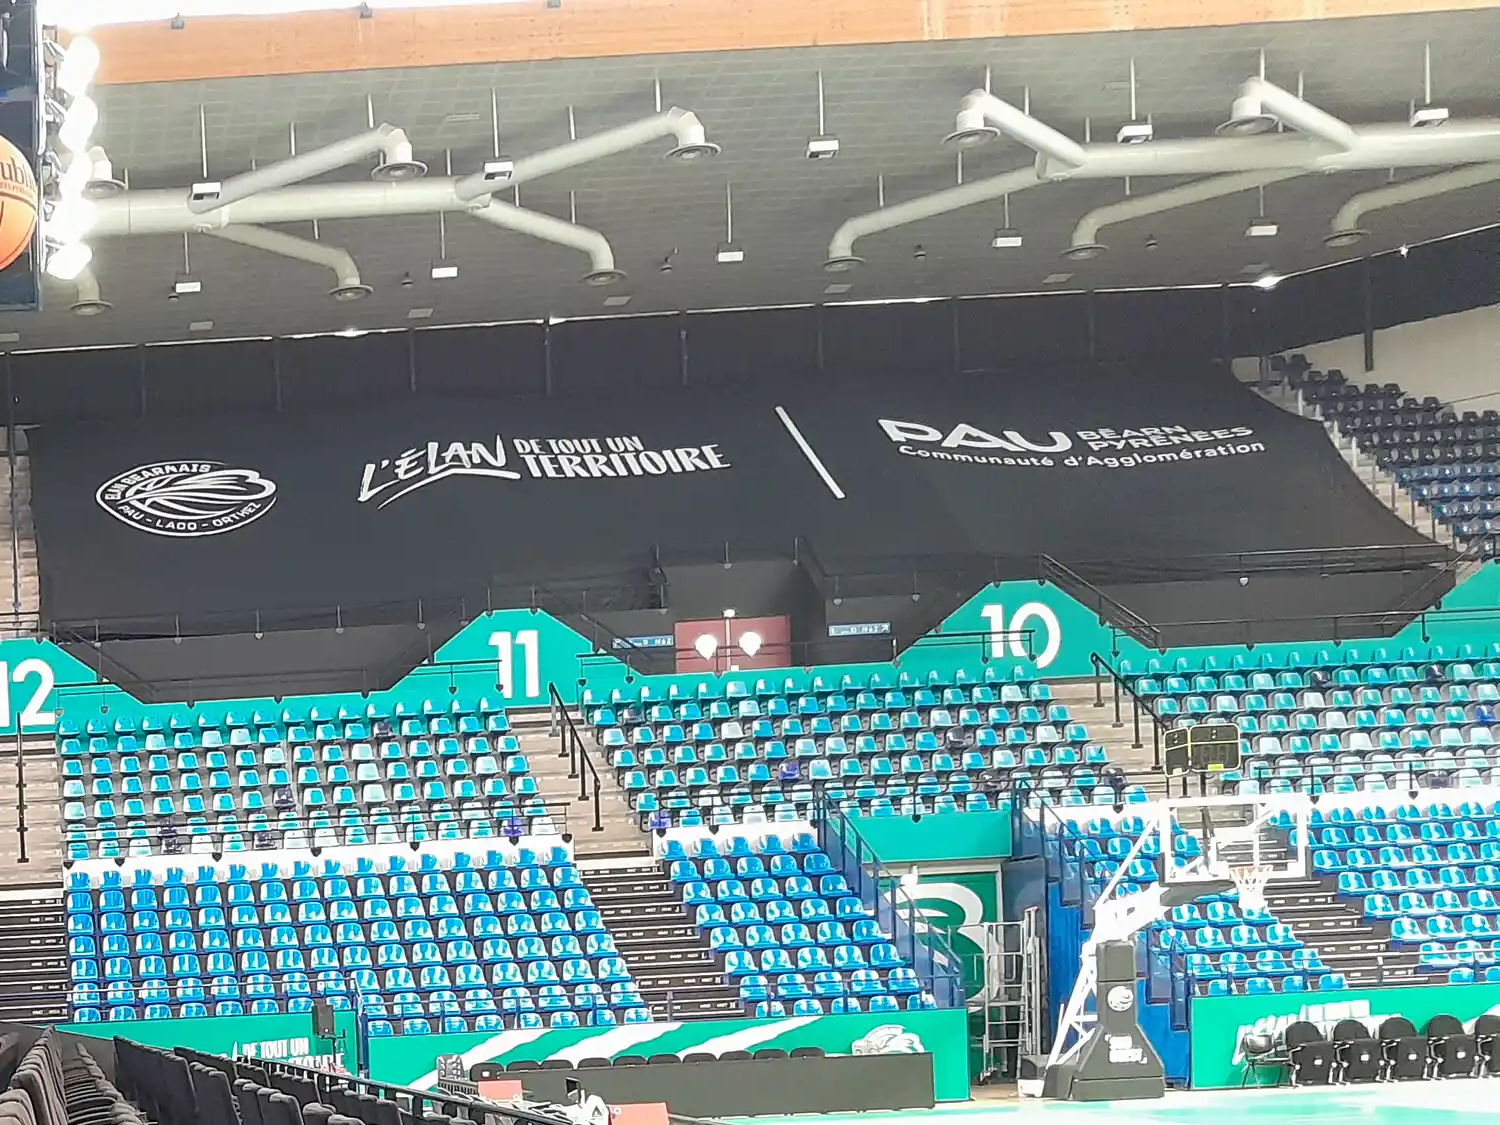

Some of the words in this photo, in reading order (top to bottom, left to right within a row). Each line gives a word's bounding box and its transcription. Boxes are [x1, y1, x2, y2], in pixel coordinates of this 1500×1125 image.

[512, 438, 546, 455] DE
[545, 438, 600, 454] TOUT
[605, 436, 645, 453] UN
[877, 419, 1072, 453] PAU
[357, 434, 507, 503] L'ÉLAN
[520, 444, 732, 478] TERRITOIRE
[898, 444, 1055, 467] Communauté
[1063, 441, 1266, 468] d'Agglomération
[117, 504, 145, 521] PAU
[211, 501, 262, 527] ORTHEZ
[980, 601, 1061, 670] 10
[488, 629, 540, 700] 11
[260, 1039, 288, 1059] TOUT
[289, 1037, 309, 1056] UN
